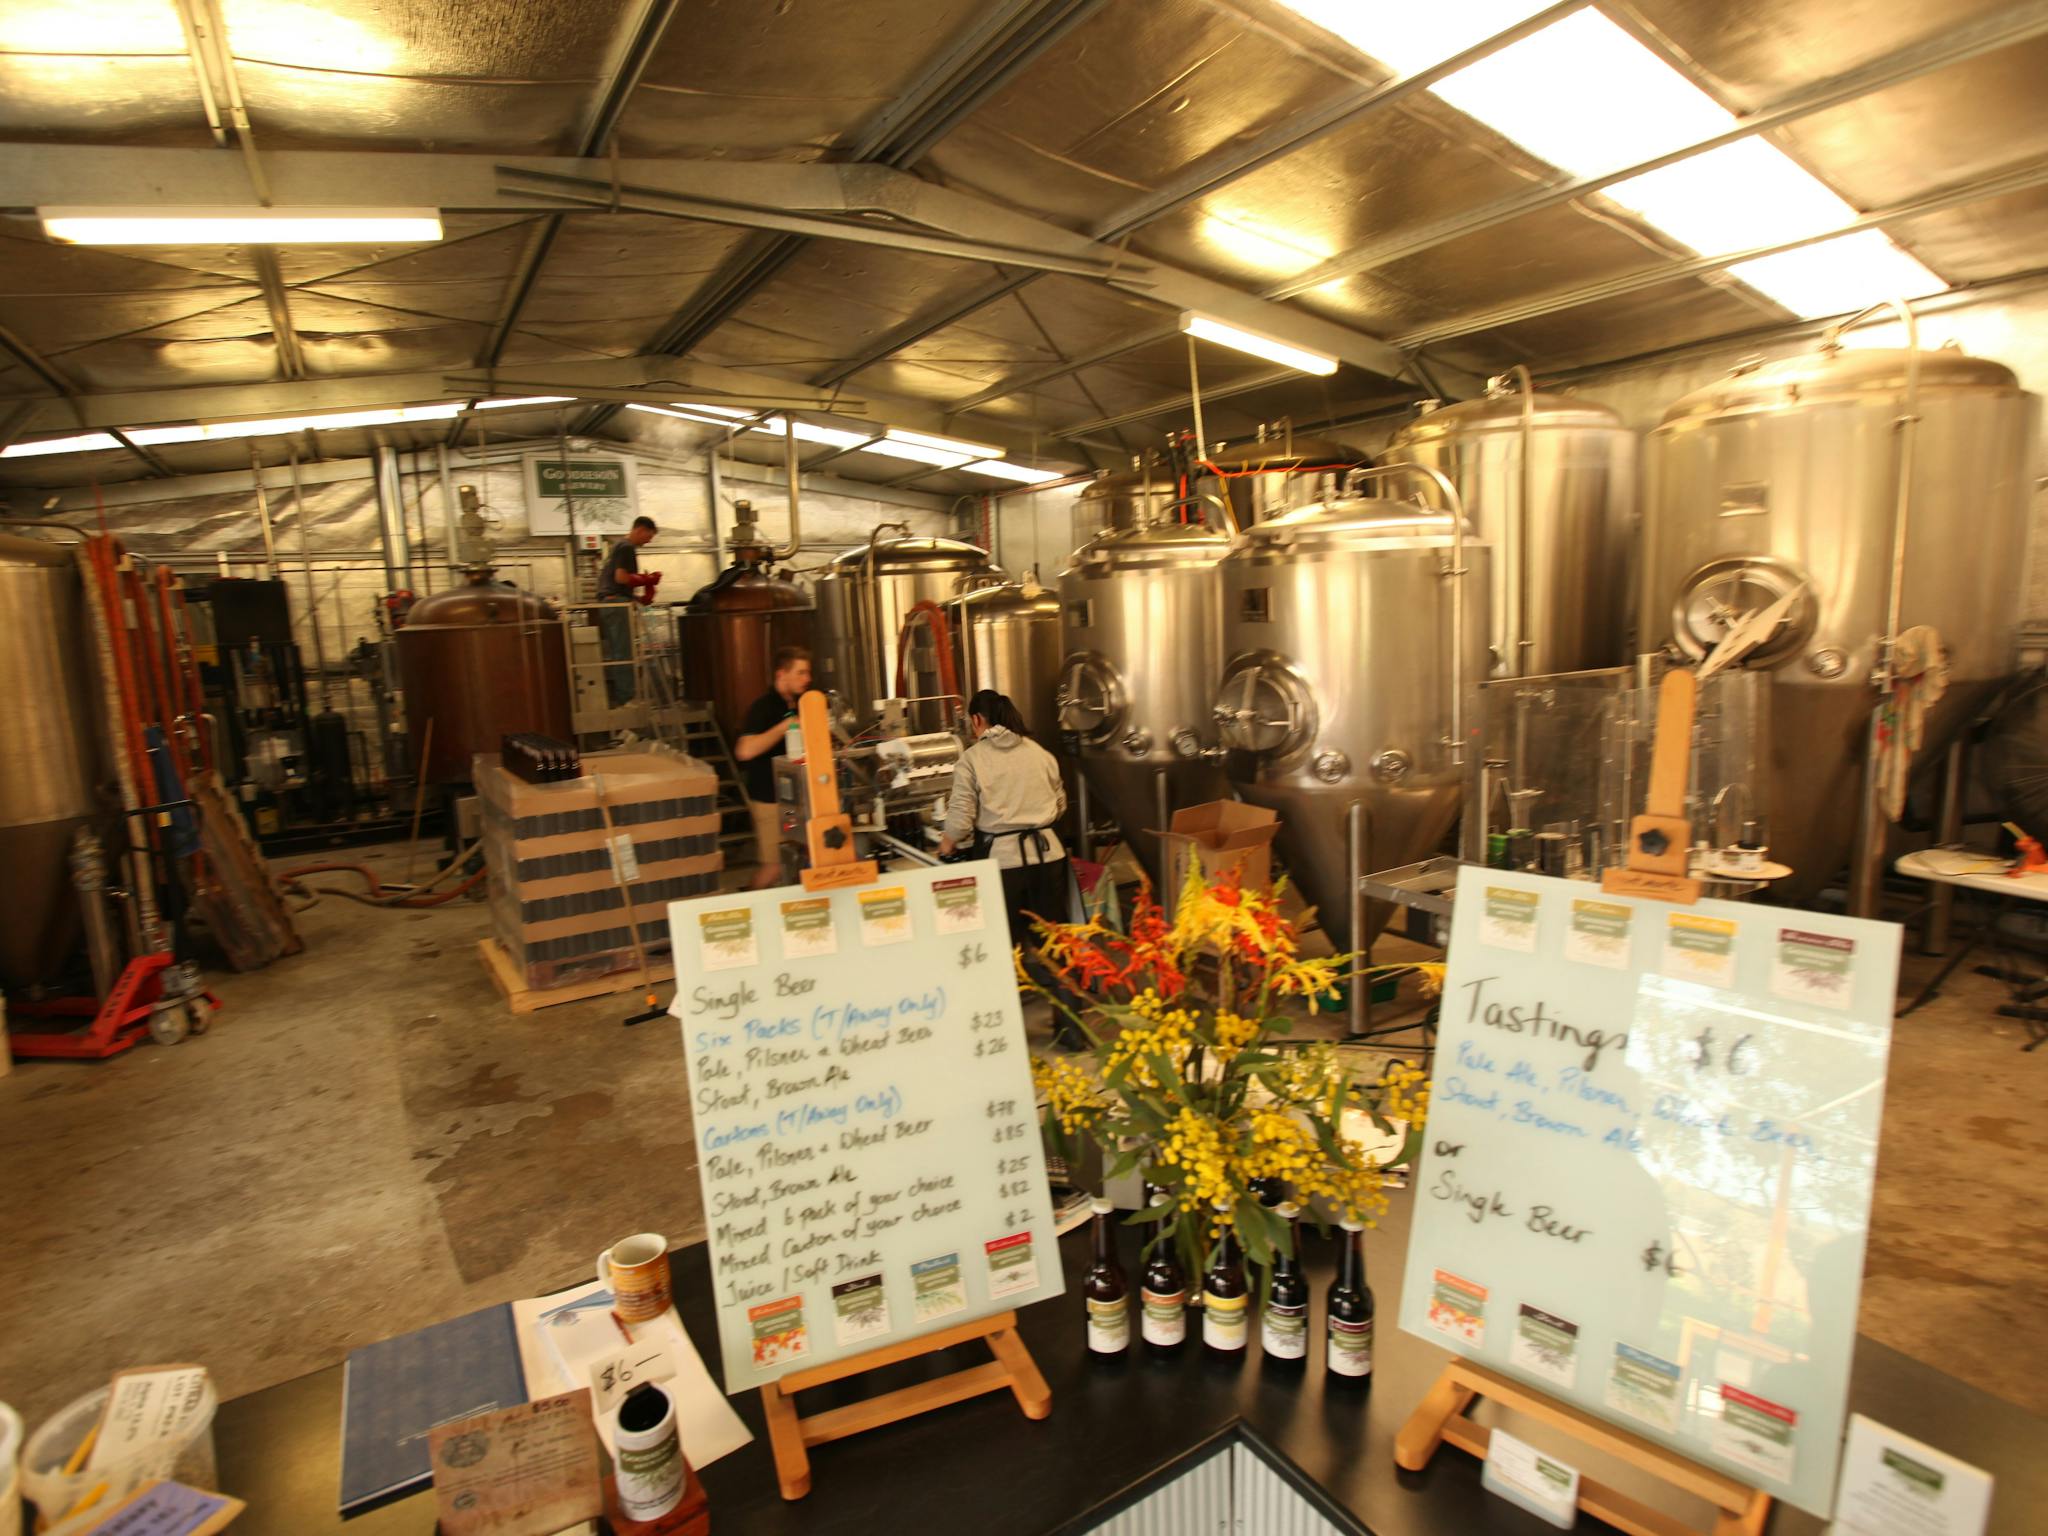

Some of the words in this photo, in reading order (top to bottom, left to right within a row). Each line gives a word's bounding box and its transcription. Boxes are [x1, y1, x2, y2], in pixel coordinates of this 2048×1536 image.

[690, 981, 759, 1020] Single
[774, 973, 816, 997] Beer
[958, 943, 988, 969] $6
[696, 1032, 731, 1052] Six
[743, 1017, 801, 1039] Packs
[744, 1046, 810, 1072] Pilsner
[840, 1031, 892, 1056] Wheat
[896, 1025, 933, 1045] Beer
[970, 1010, 1004, 1032] $23
[1457, 1040, 1496, 1073] Pale
[1460, 976, 1629, 1072] Tastings
[1692, 1027, 1757, 1076] $6
[766, 1076, 820, 1100] Brown
[824, 1065, 851, 1083] Ale
[974, 1036, 1008, 1058] $26
[703, 1123, 770, 1151] Cartons
[757, 1142, 815, 1169] Pilsner
[840, 1125, 890, 1150] Wheat
[894, 1119, 934, 1139] Beer
[1434, 1140, 1466, 1158] or
[1513, 1101, 1588, 1136] Brown
[1603, 1128, 1642, 1152] Ale
[716, 1216, 767, 1248] Mixed
[784, 1207, 795, 1226] 6
[799, 1200, 837, 1229] pack
[843, 1190, 862, 1216] of
[863, 1190, 902, 1216] your
[908, 1175, 955, 1196] choice
[998, 1155, 1031, 1175] $25
[768, 1179, 822, 1200] Brown
[827, 1164, 858, 1184] Ale
[1430, 1169, 1514, 1224] Single
[1525, 1205, 1593, 1243] Beer
[718, 1243, 771, 1276] Mixed
[783, 1230, 838, 1258] Carton
[841, 1217, 861, 1241] of
[863, 1215, 904, 1238] your
[911, 1198, 962, 1222] choice
[722, 1279, 775, 1307] Juice
[834, 1249, 884, 1276] Drink
[1005, 1208, 1035, 1228] $2
